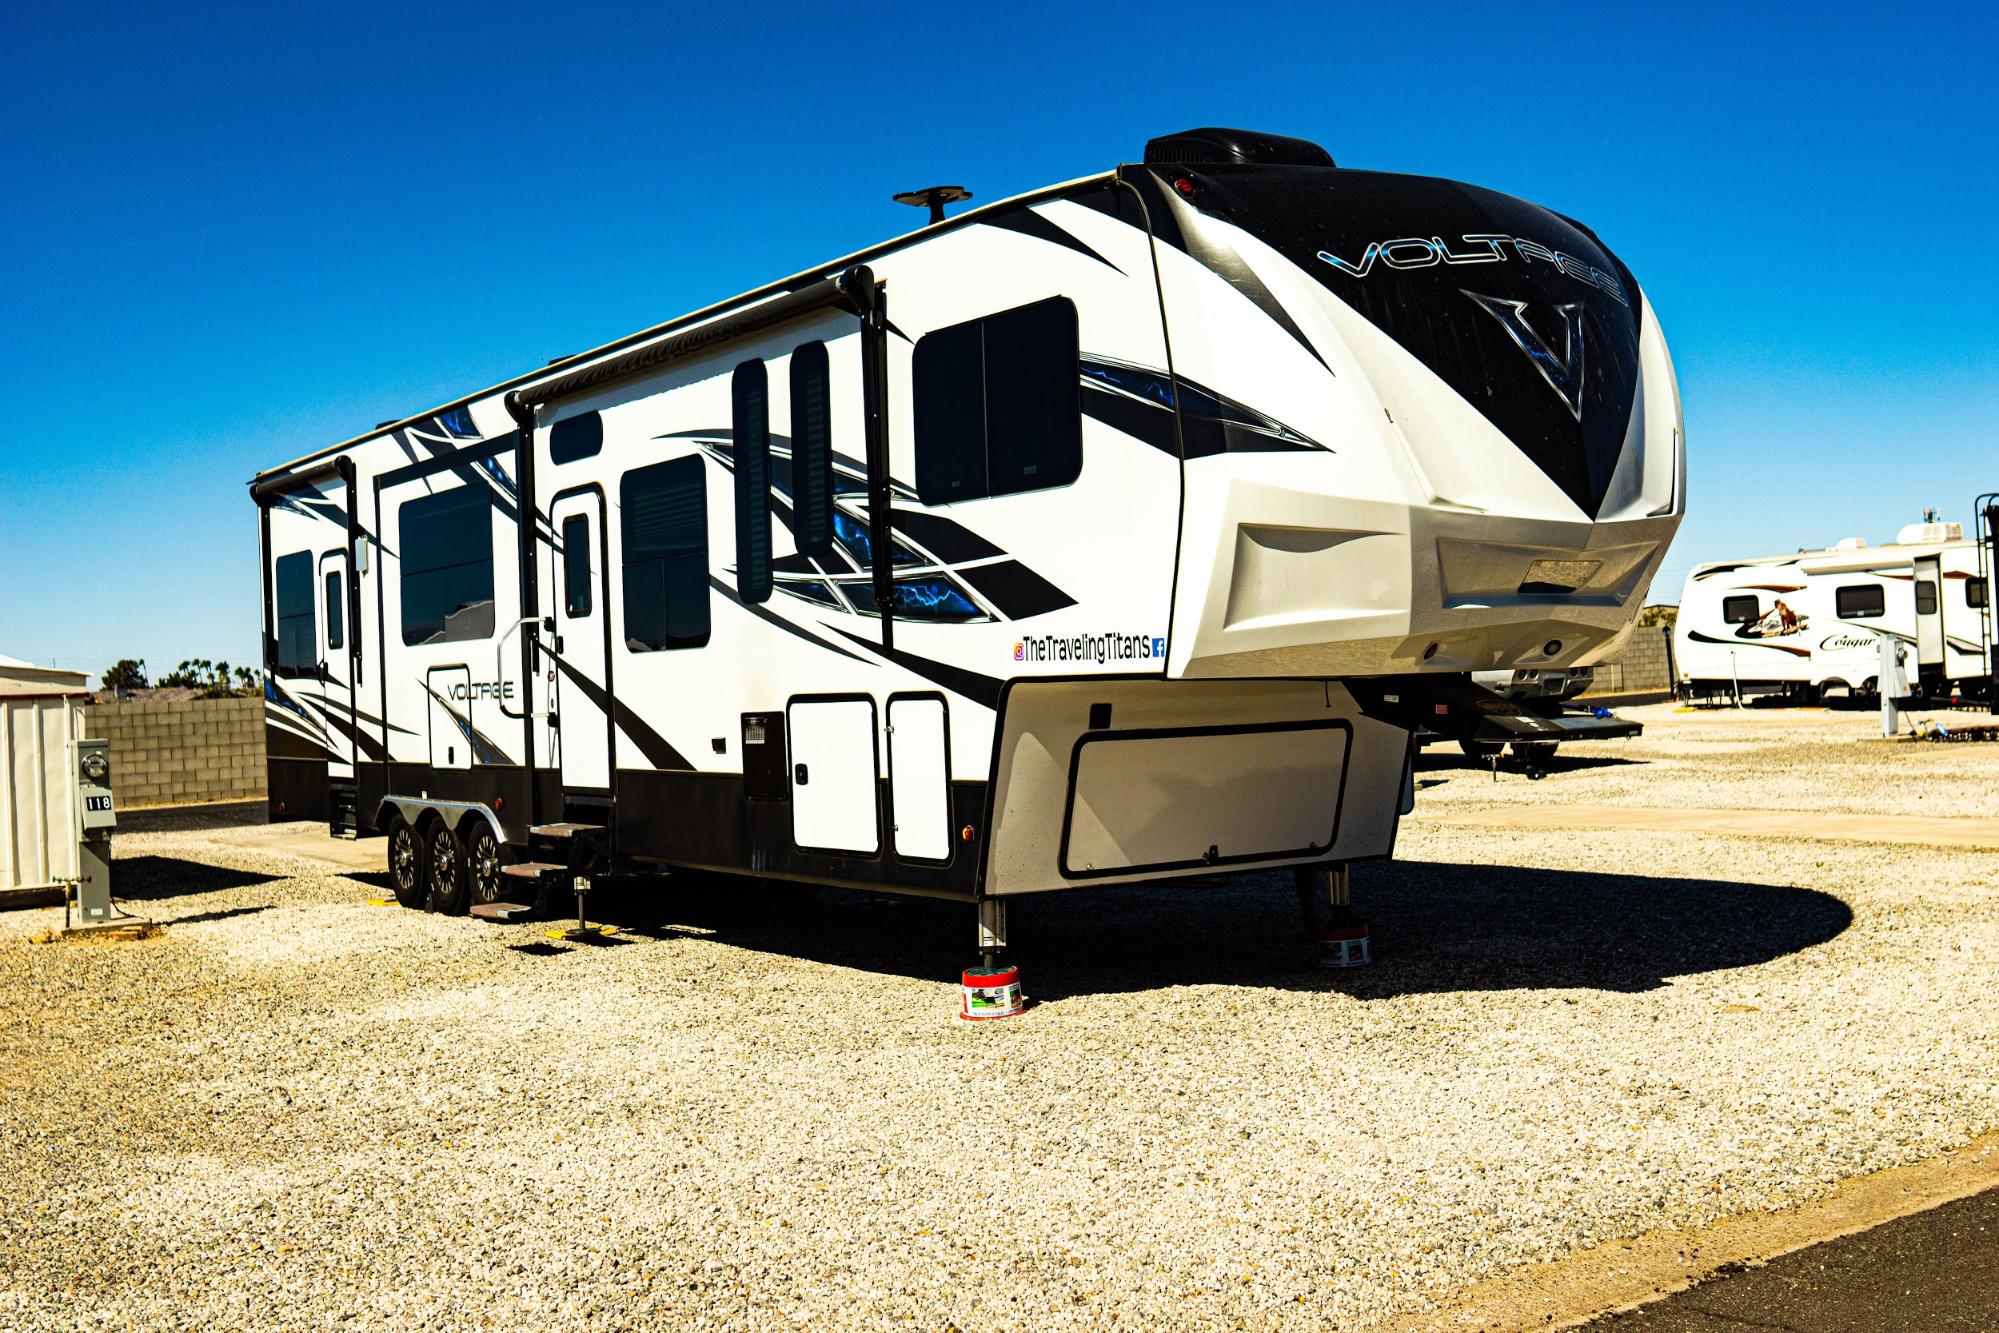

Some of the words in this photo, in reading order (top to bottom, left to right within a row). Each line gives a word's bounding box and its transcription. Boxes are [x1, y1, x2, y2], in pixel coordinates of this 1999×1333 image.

[1317, 234, 1629, 307] VOLTAGE
[1023, 632, 1151, 664] TheTravelingTitans
[1819, 634, 1876, 652] Cougar
[447, 681, 514, 701] VOLTAGE
[88, 797, 111, 811] 118
